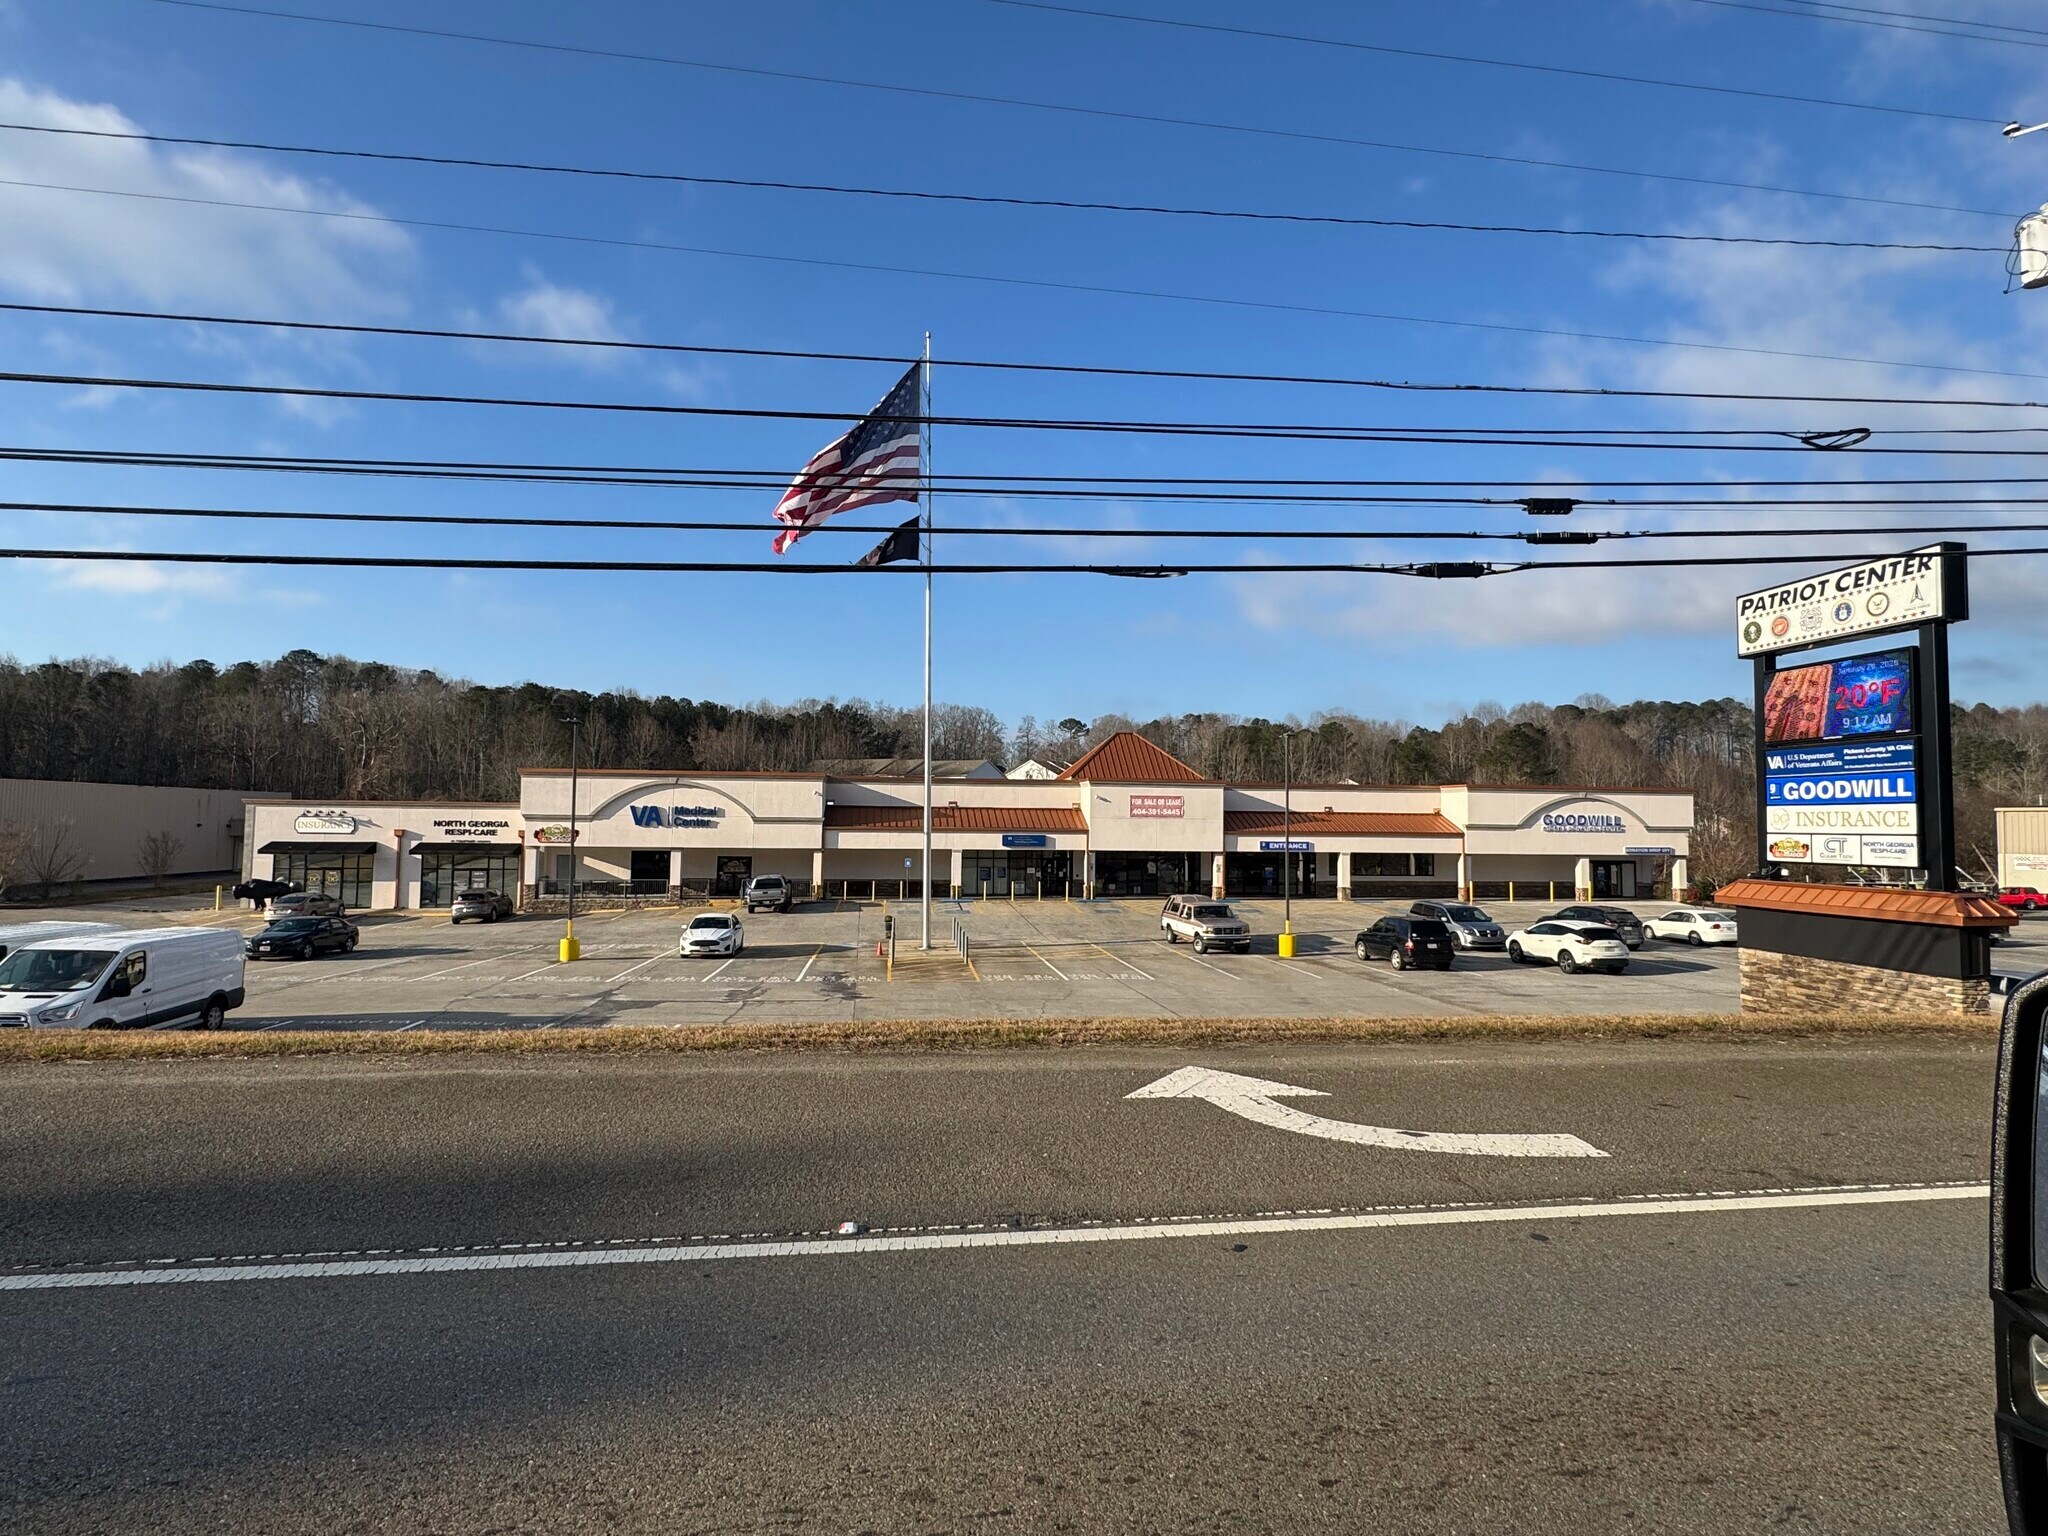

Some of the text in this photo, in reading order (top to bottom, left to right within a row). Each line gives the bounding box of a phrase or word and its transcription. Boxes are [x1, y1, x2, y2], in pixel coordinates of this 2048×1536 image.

[1741, 556, 1932, 616] PATRIOT CENTER
[1835, 679, 1900, 710] 20°F
[1842, 713, 1892, 728] 9:17 AM
[1767, 756, 1784, 769] VA
[1799, 752, 1835, 761] Department
[1787, 761, 1795, 769] of
[1783, 778, 1912, 800] GOODWILL
[630, 805, 662, 826] VA
[674, 806, 717, 816] Medical
[468, 820, 510, 828] GEORGIA
[674, 817, 711, 827] Center
[1543, 814, 1622, 826] GOODWILL
[1796, 811, 1910, 827] INSURANCE
